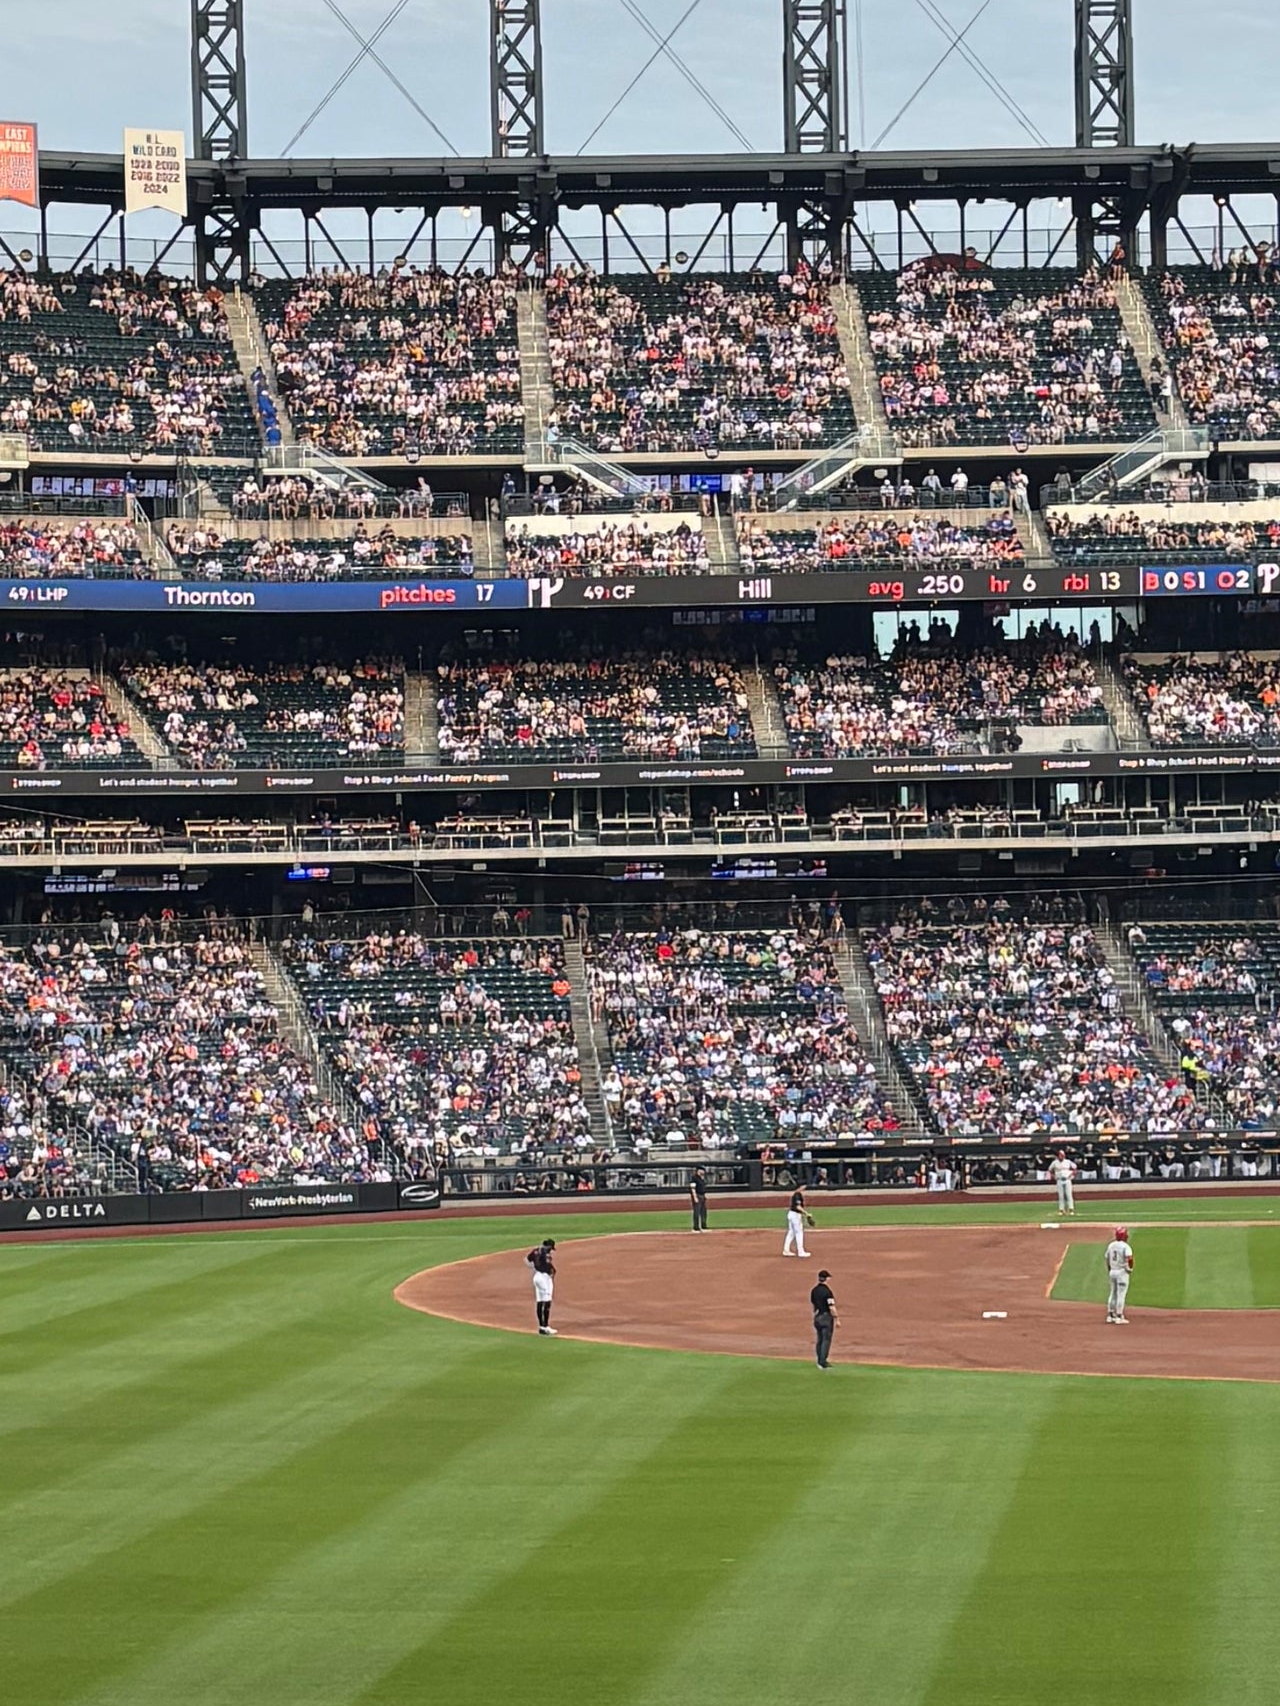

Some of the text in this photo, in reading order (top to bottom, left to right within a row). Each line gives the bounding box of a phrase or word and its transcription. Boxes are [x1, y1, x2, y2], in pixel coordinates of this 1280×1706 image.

[143, 183, 168, 194] 2024
[738, 578, 772, 599] Hill
[868, 571, 1121, 600] avg .250 hr 6 rbi 13
[164, 586, 256, 606] Thornton
[380, 584, 494, 608] pitches 17
[46, 1203, 106, 1219] DELTA
